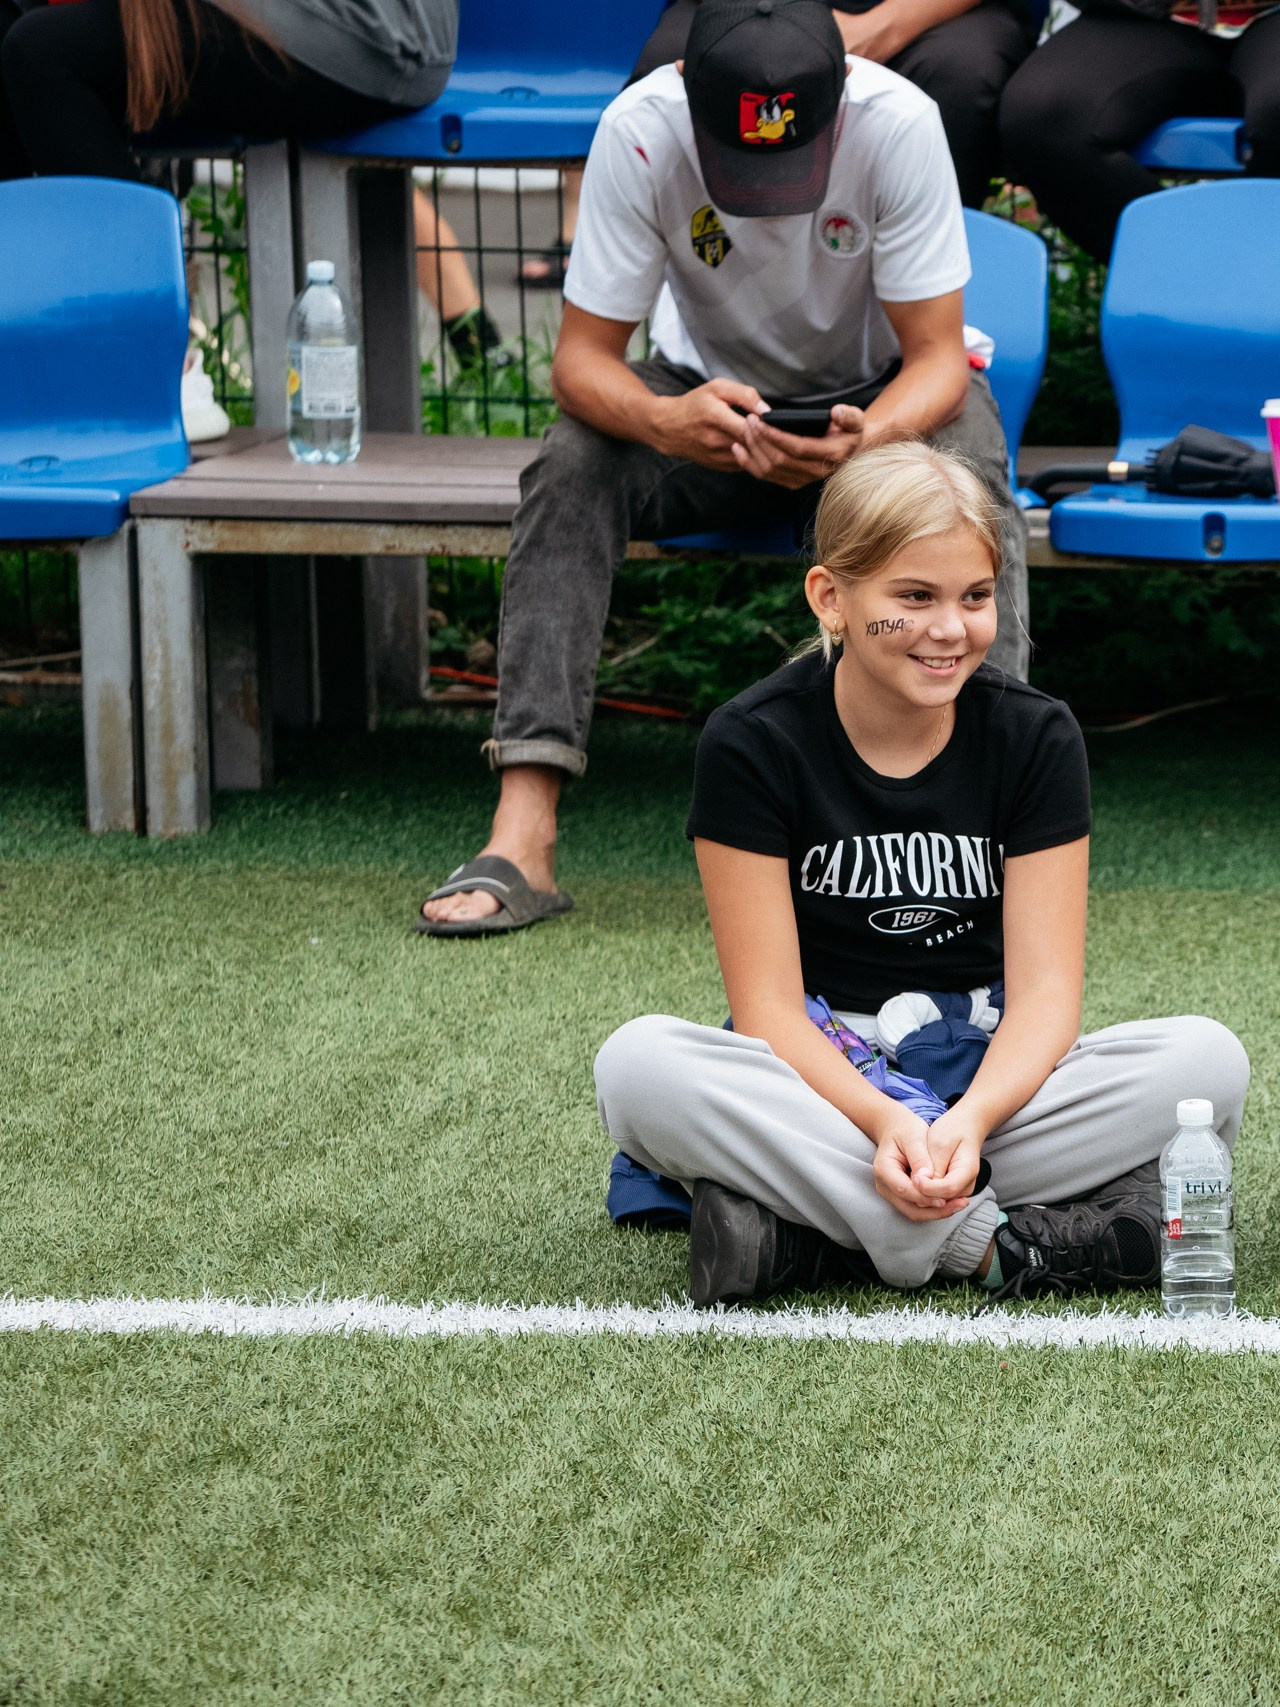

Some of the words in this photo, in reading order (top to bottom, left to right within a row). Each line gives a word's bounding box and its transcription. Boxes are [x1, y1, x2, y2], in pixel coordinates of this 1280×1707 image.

[800, 831, 1005, 899] CALIFORNI
[891, 911, 937, 929] 1961
[925, 920, 975, 948] BEACH
